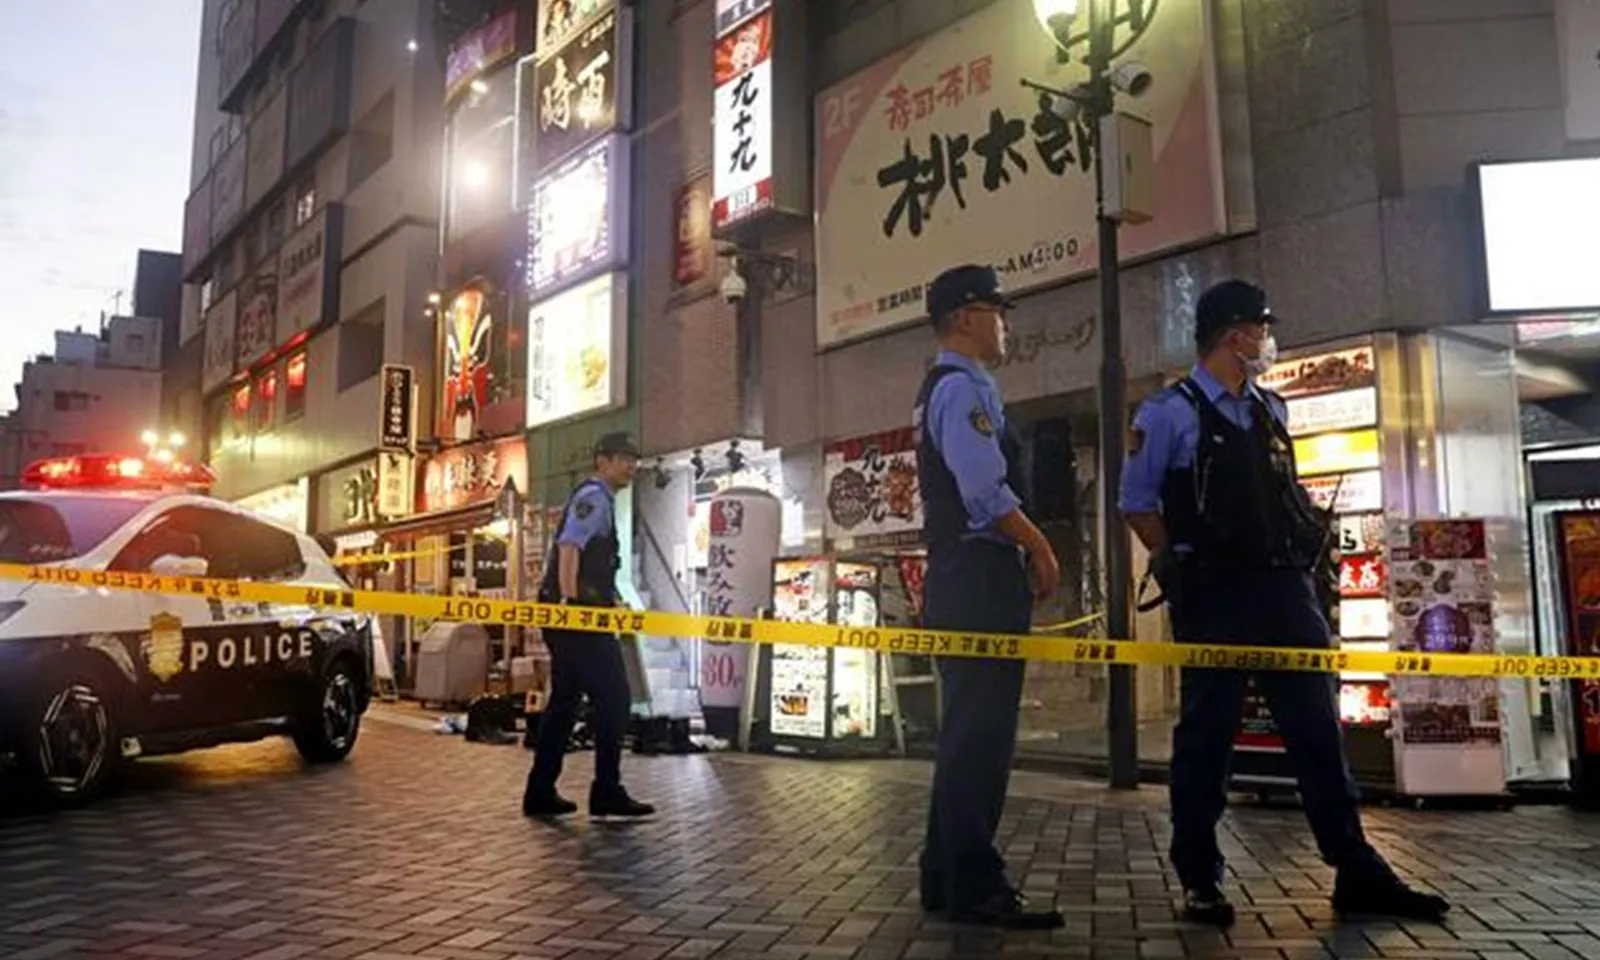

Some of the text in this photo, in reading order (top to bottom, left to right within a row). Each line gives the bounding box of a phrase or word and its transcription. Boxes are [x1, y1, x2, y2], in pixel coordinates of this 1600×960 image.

[825, 87, 862, 136] 2F
[730, 72, 758, 173] 九十九
[877, 93, 1099, 238] 桃太郎
[707, 544, 735, 646] 飲み放
[441, 600, 491, 620] OUT
[501, 604, 570, 627] KEEP
[835, 628, 880, 648] OUT
[888, 632, 952, 652] KEEP
[189, 631, 313, 672] POLICE
[1185, 649, 1227, 668] OUT
[1234, 650, 1289, 669] KEEP
[1493, 658, 1529, 676] OUT
[1533, 659, 1583, 676] KEEP
